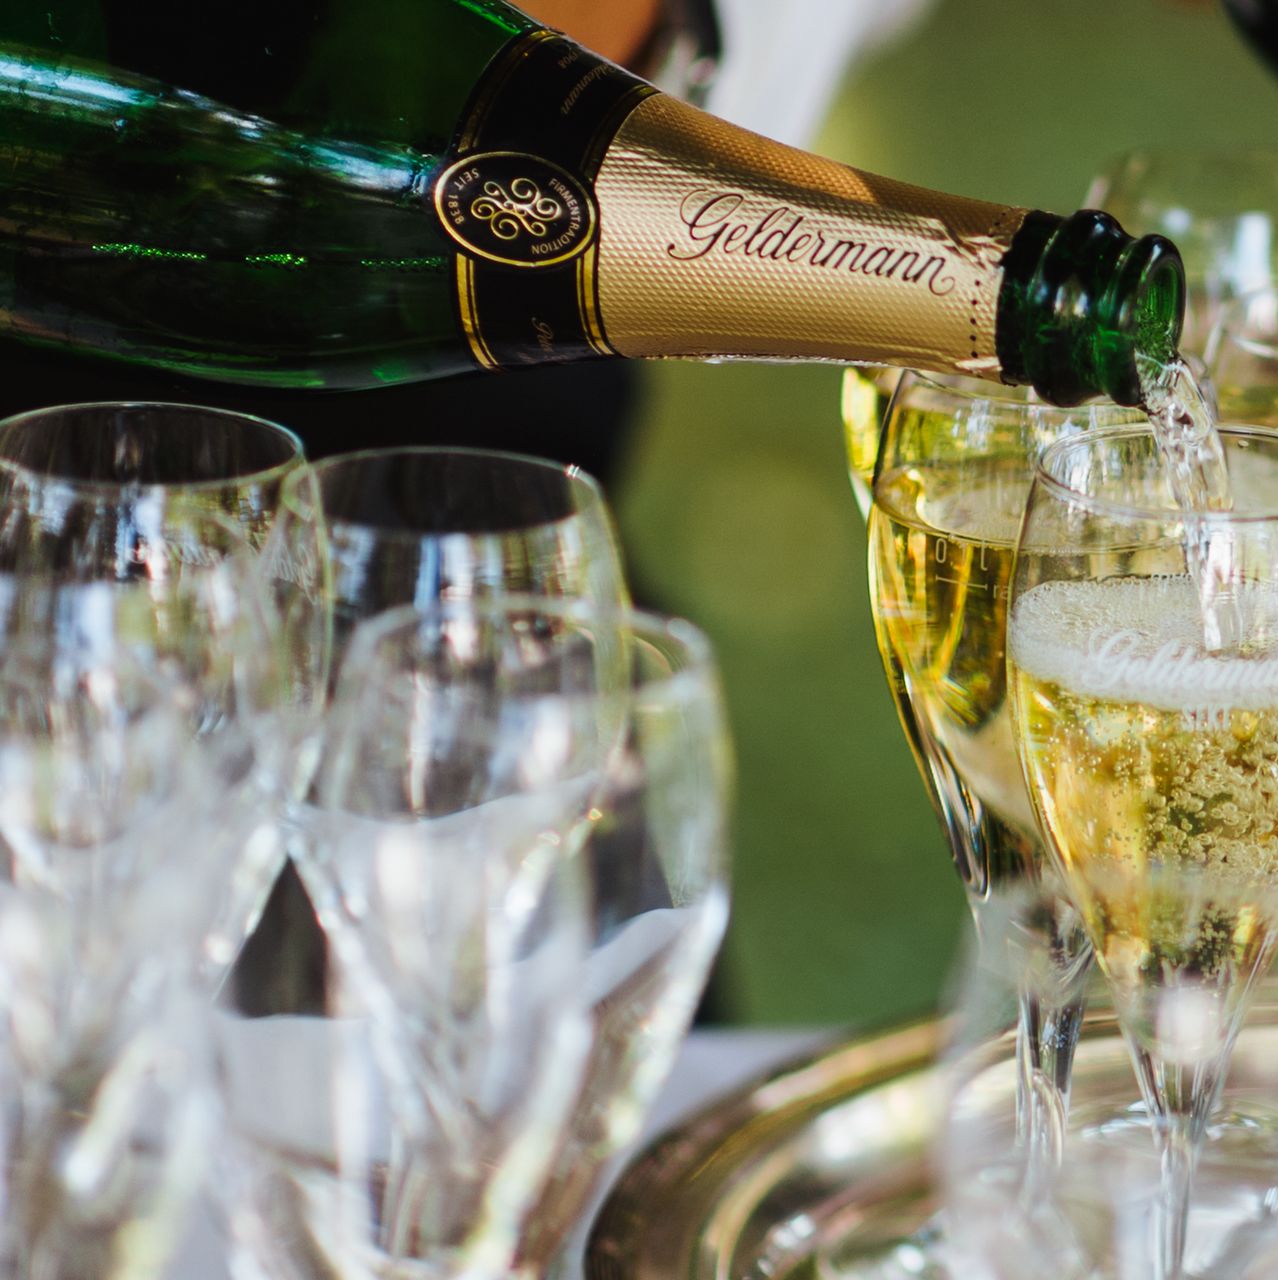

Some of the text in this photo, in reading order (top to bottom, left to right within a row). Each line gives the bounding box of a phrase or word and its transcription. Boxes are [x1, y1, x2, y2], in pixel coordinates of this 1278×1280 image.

[447, 167, 480, 225] SEIT 1838
[531, 177, 581, 255] FIRMENTRADITION
[667, 188, 955, 296] Geldermann
